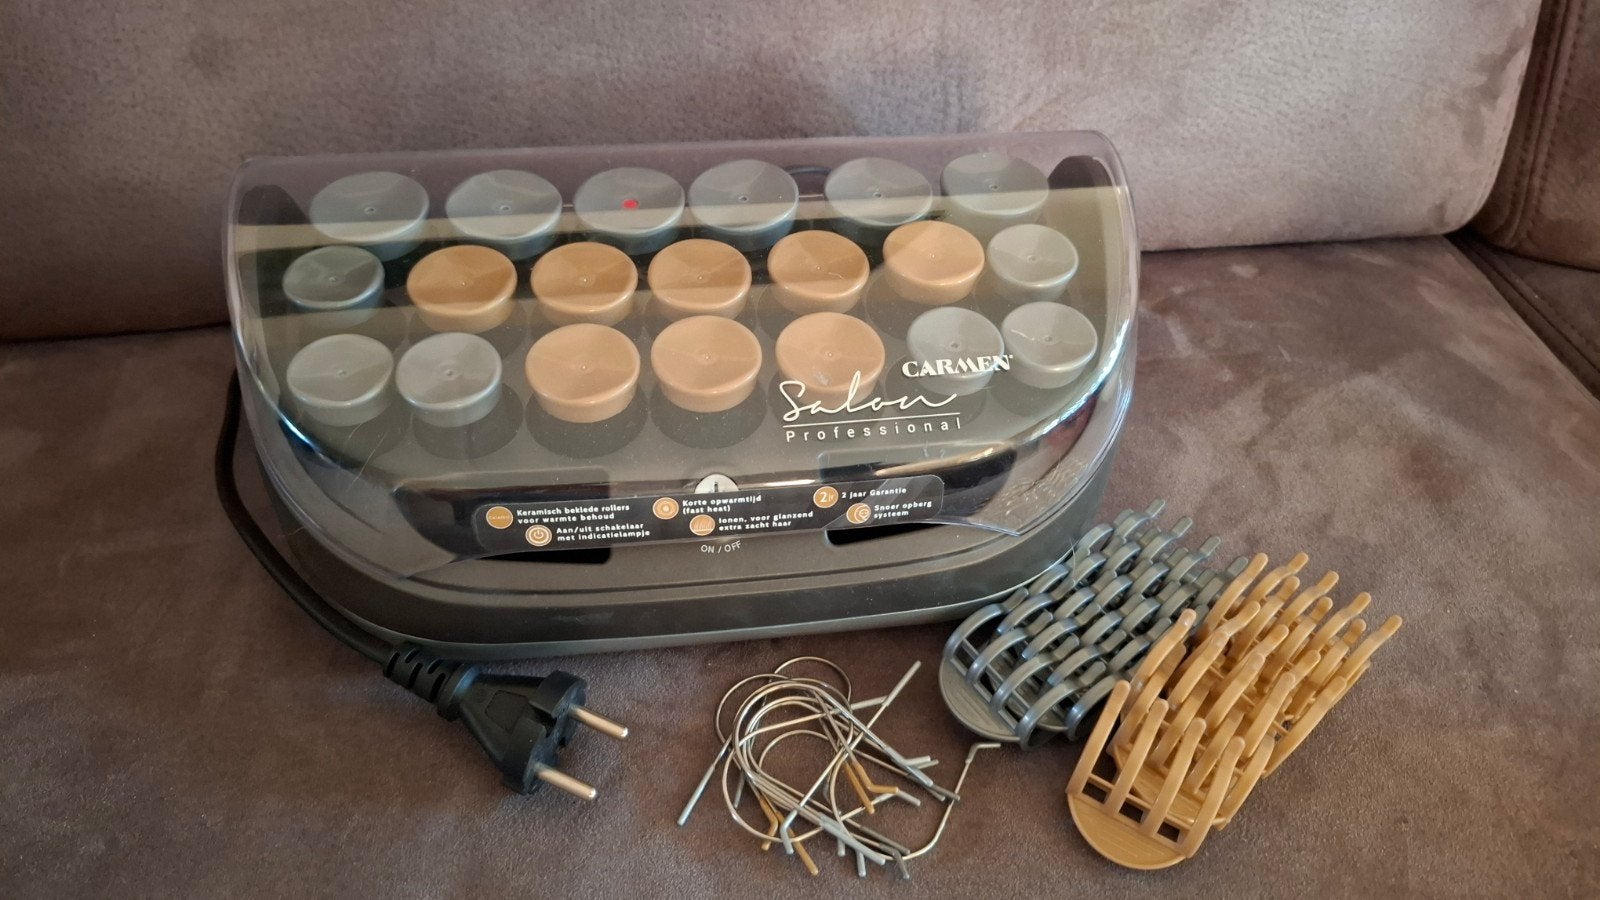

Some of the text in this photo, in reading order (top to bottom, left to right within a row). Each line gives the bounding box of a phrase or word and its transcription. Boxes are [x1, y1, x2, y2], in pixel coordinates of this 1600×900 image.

[902, 354, 1008, 378] CARMEN
[779, 370, 957, 422] Salon
[785, 417, 961, 442] Professional
[849, 491, 867, 499] jaar
[869, 487, 907, 497] Garantie
[710, 495, 762, 506] opwarmtijd
[902, 501, 932, 509] opberg
[516, 504, 630, 516] Keramisch beklede rollers
[682, 507, 704, 515] (fast
[873, 511, 909, 519] systeem
[542, 515, 577, 523] warmte
[580, 513, 615, 521] behoud
[773, 511, 814, 521] glanzend
[556, 523, 644, 534] Aan/uit schakelaar
[745, 521, 769, 529] zacht
[578, 530, 651, 540] indicatielampje
[700, 544, 715, 553] ON
[724, 540, 741, 552] OFF
